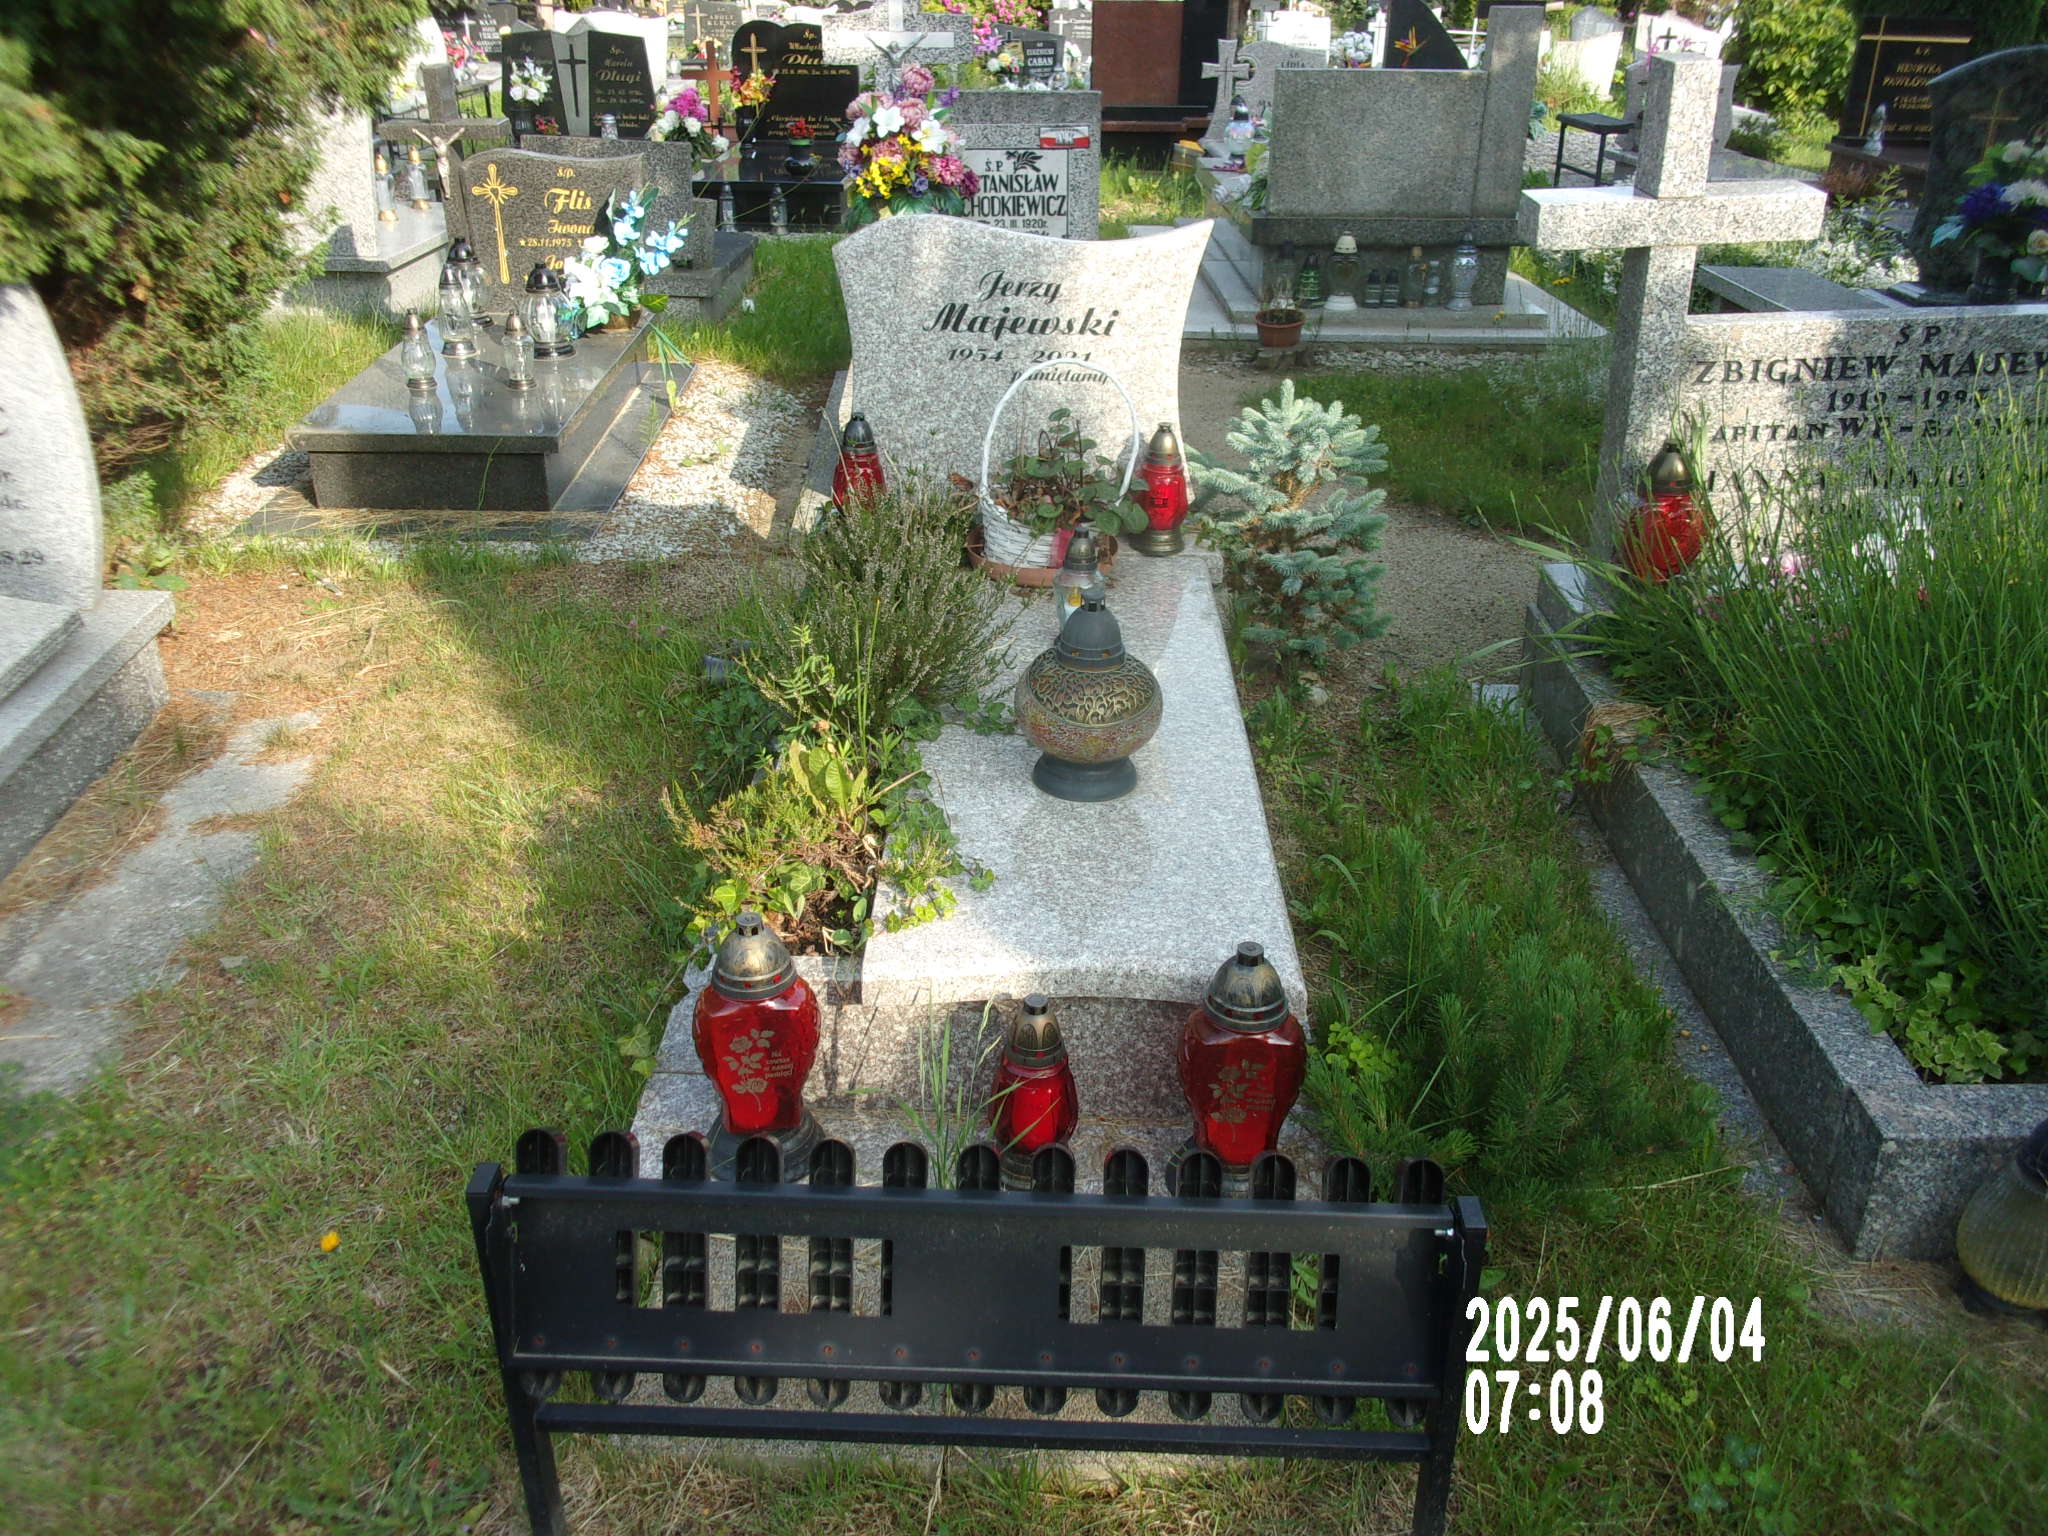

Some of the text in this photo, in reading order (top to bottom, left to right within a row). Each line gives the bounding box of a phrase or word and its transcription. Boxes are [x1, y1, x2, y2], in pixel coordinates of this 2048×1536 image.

[979, 173, 1059, 193] TANISŁAW
[544, 187, 593, 214] Flis
[962, 195, 1067, 217] CHODKIEWICZ
[977, 270, 1063, 303] Jerzy
[922, 302, 1120, 341] Majewski
[1693, 355, 1899, 386] ZBIGNIEW
[1692, 422, 1829, 443] APITAN
